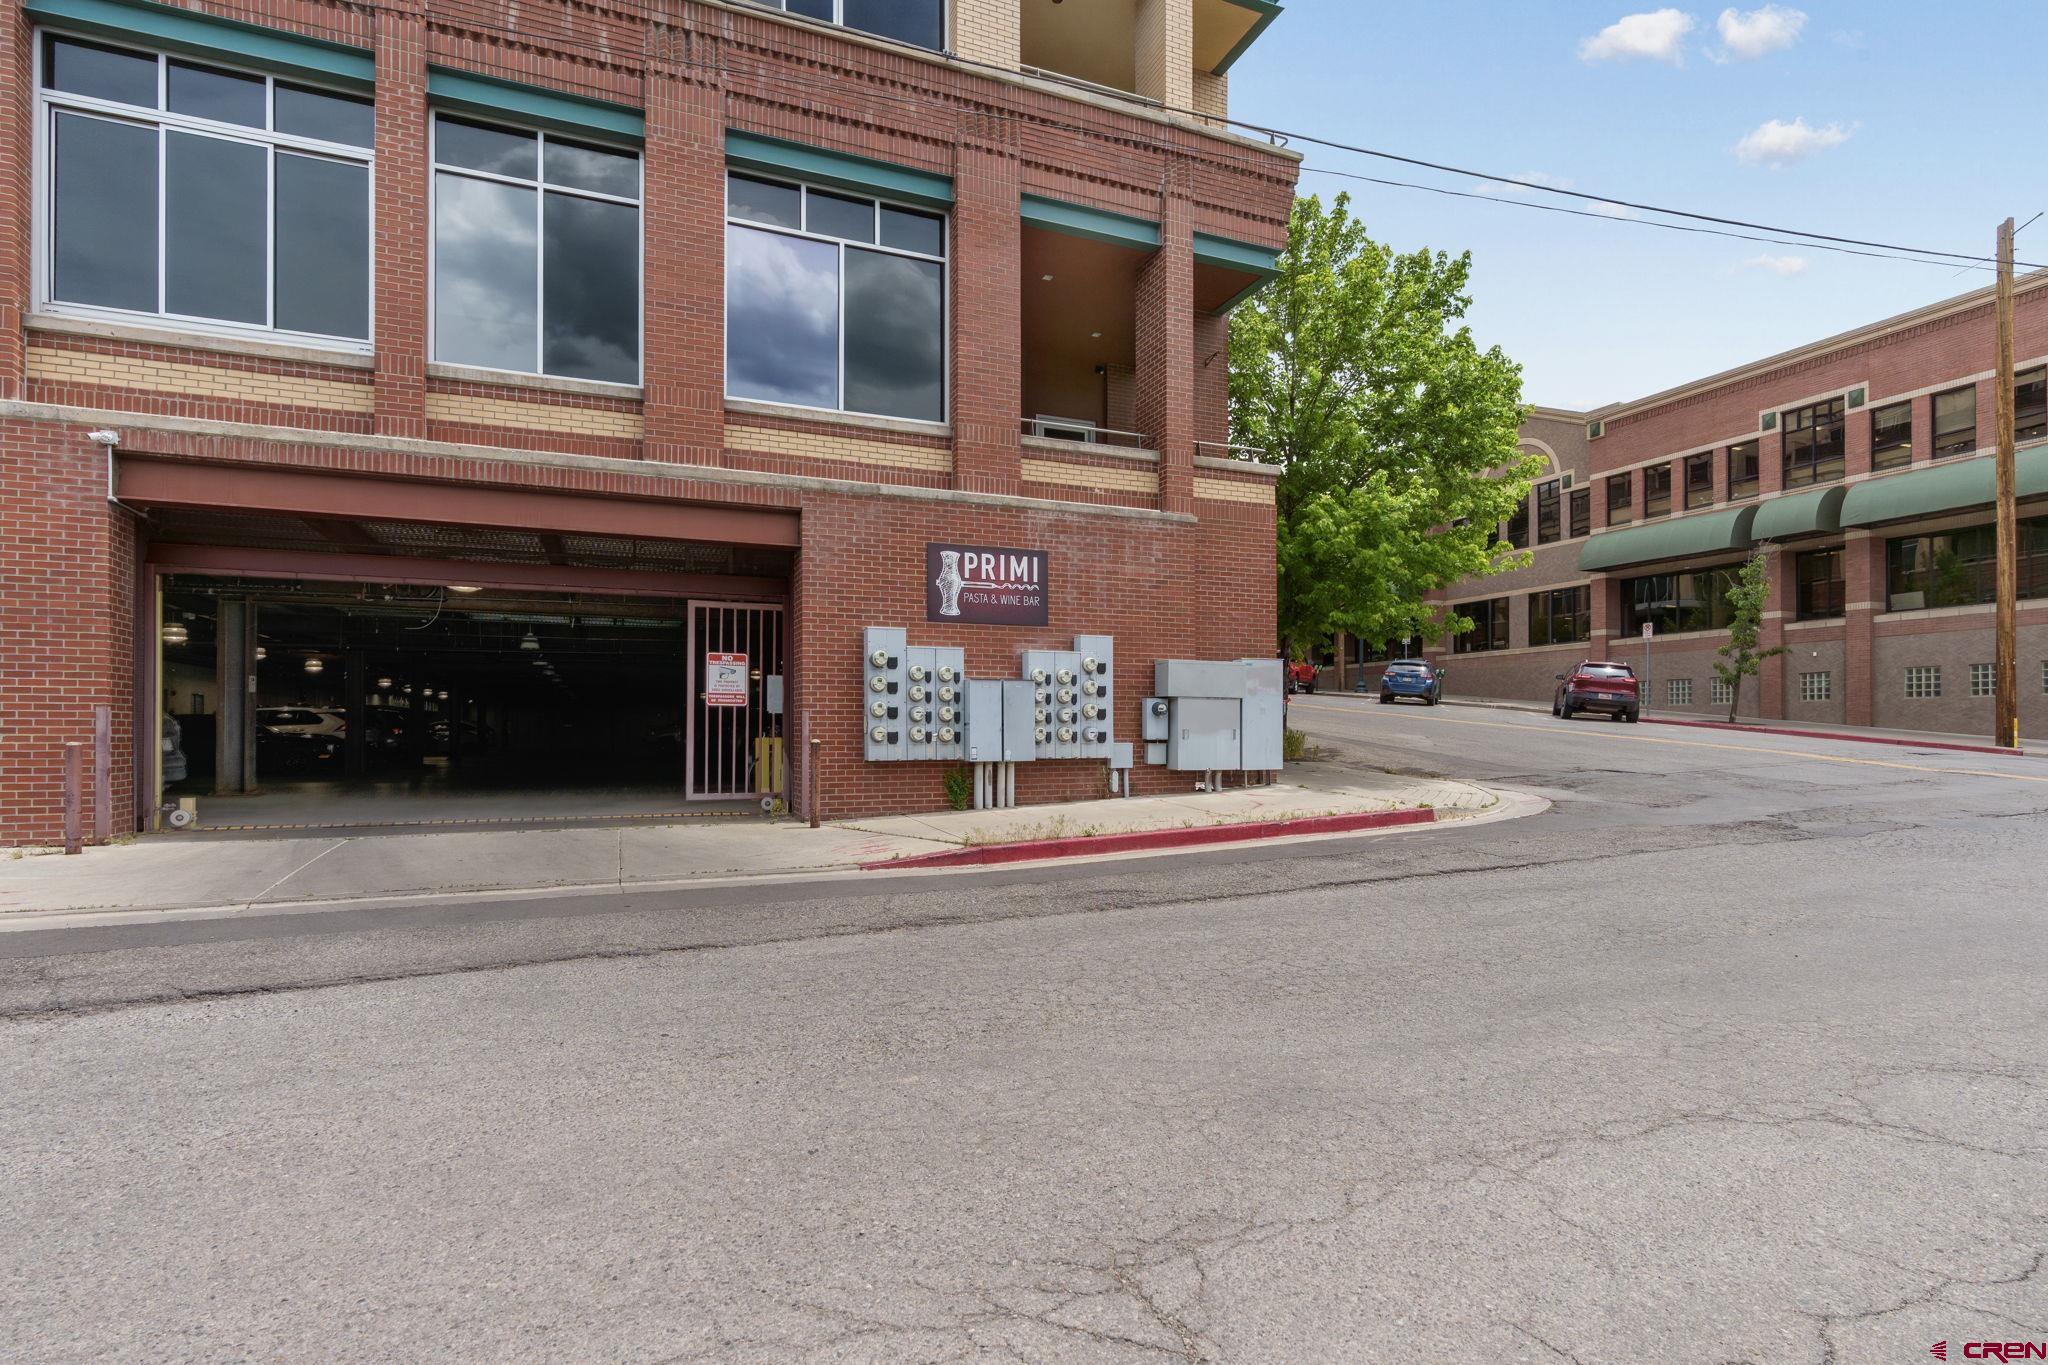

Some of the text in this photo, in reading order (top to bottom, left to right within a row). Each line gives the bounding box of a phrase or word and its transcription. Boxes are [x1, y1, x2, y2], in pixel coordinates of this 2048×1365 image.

[964, 552, 1038, 583] PRIMI
[963, 592, 1040, 607] PASTA & WINE BAR
